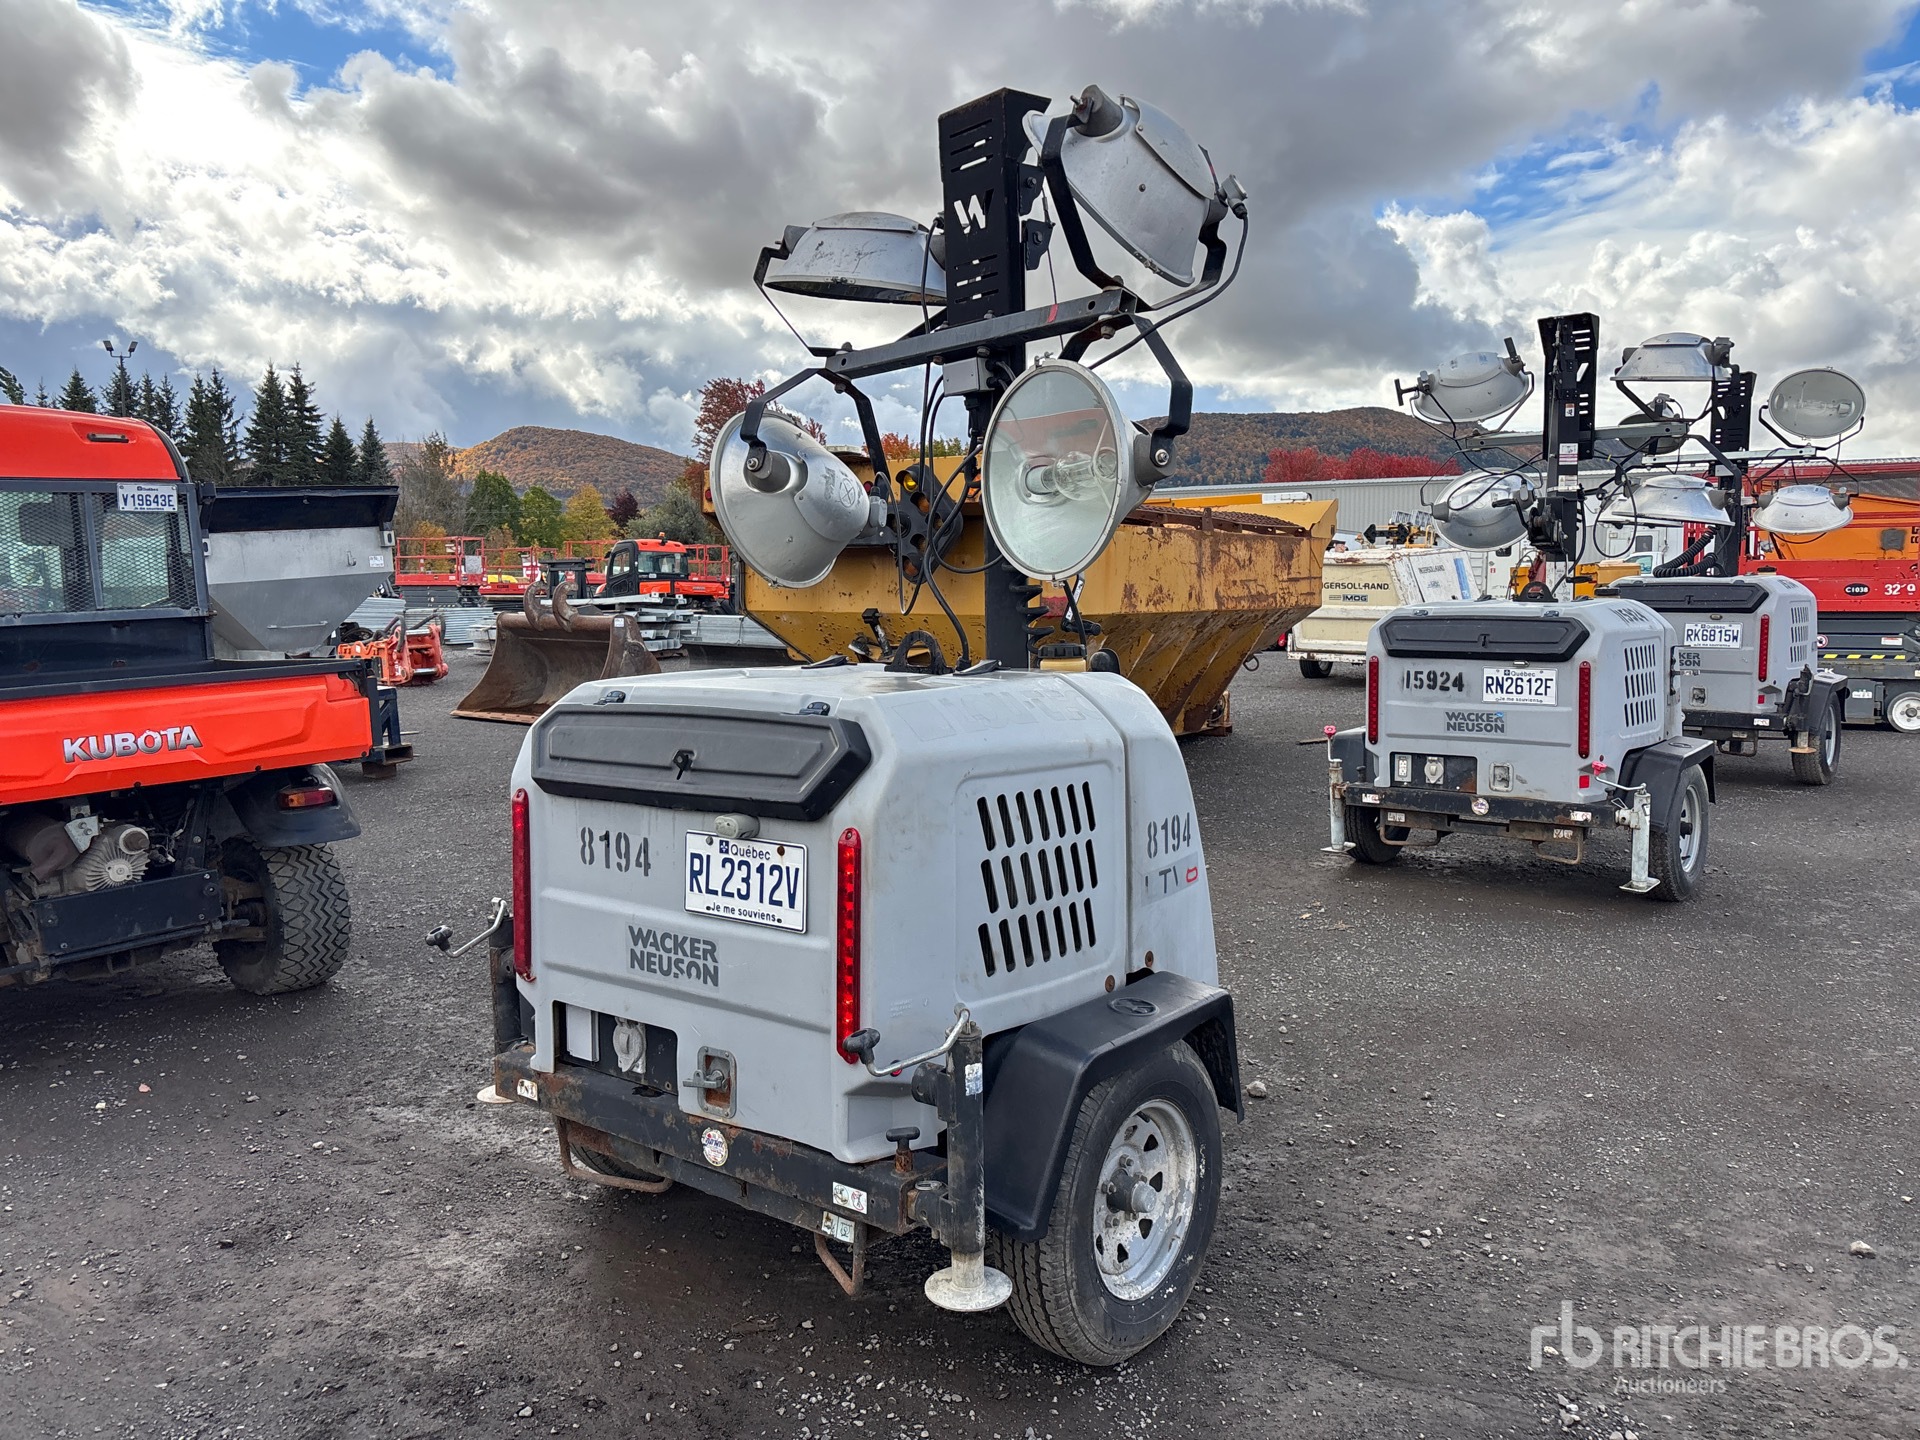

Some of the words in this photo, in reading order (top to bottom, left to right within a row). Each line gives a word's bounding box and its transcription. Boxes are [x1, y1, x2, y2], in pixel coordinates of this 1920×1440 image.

[122, 493, 175, 507] V19643E
[1322, 581, 1390, 590] GERSOLL-RAND
[1686, 628, 1739, 643] RK6815W
[1405, 670, 1465, 692] 15924
[1485, 676, 1554, 696] RN2612F
[1445, 711, 1505, 723] WACKER
[1446, 721, 1505, 733] NEUSON
[63, 725, 203, 763] KUBOTA
[1147, 812, 1191, 859] 8194
[580, 827, 651, 877] 8194
[730, 844, 771, 860] Québec
[689, 852, 800, 909] RL2312V
[711, 902, 721, 912] Je
[723, 905, 736, 915] me
[737, 908, 776, 922] souviens
[628, 925, 718, 963] WACKER
[629, 948, 719, 988] NEUSON
